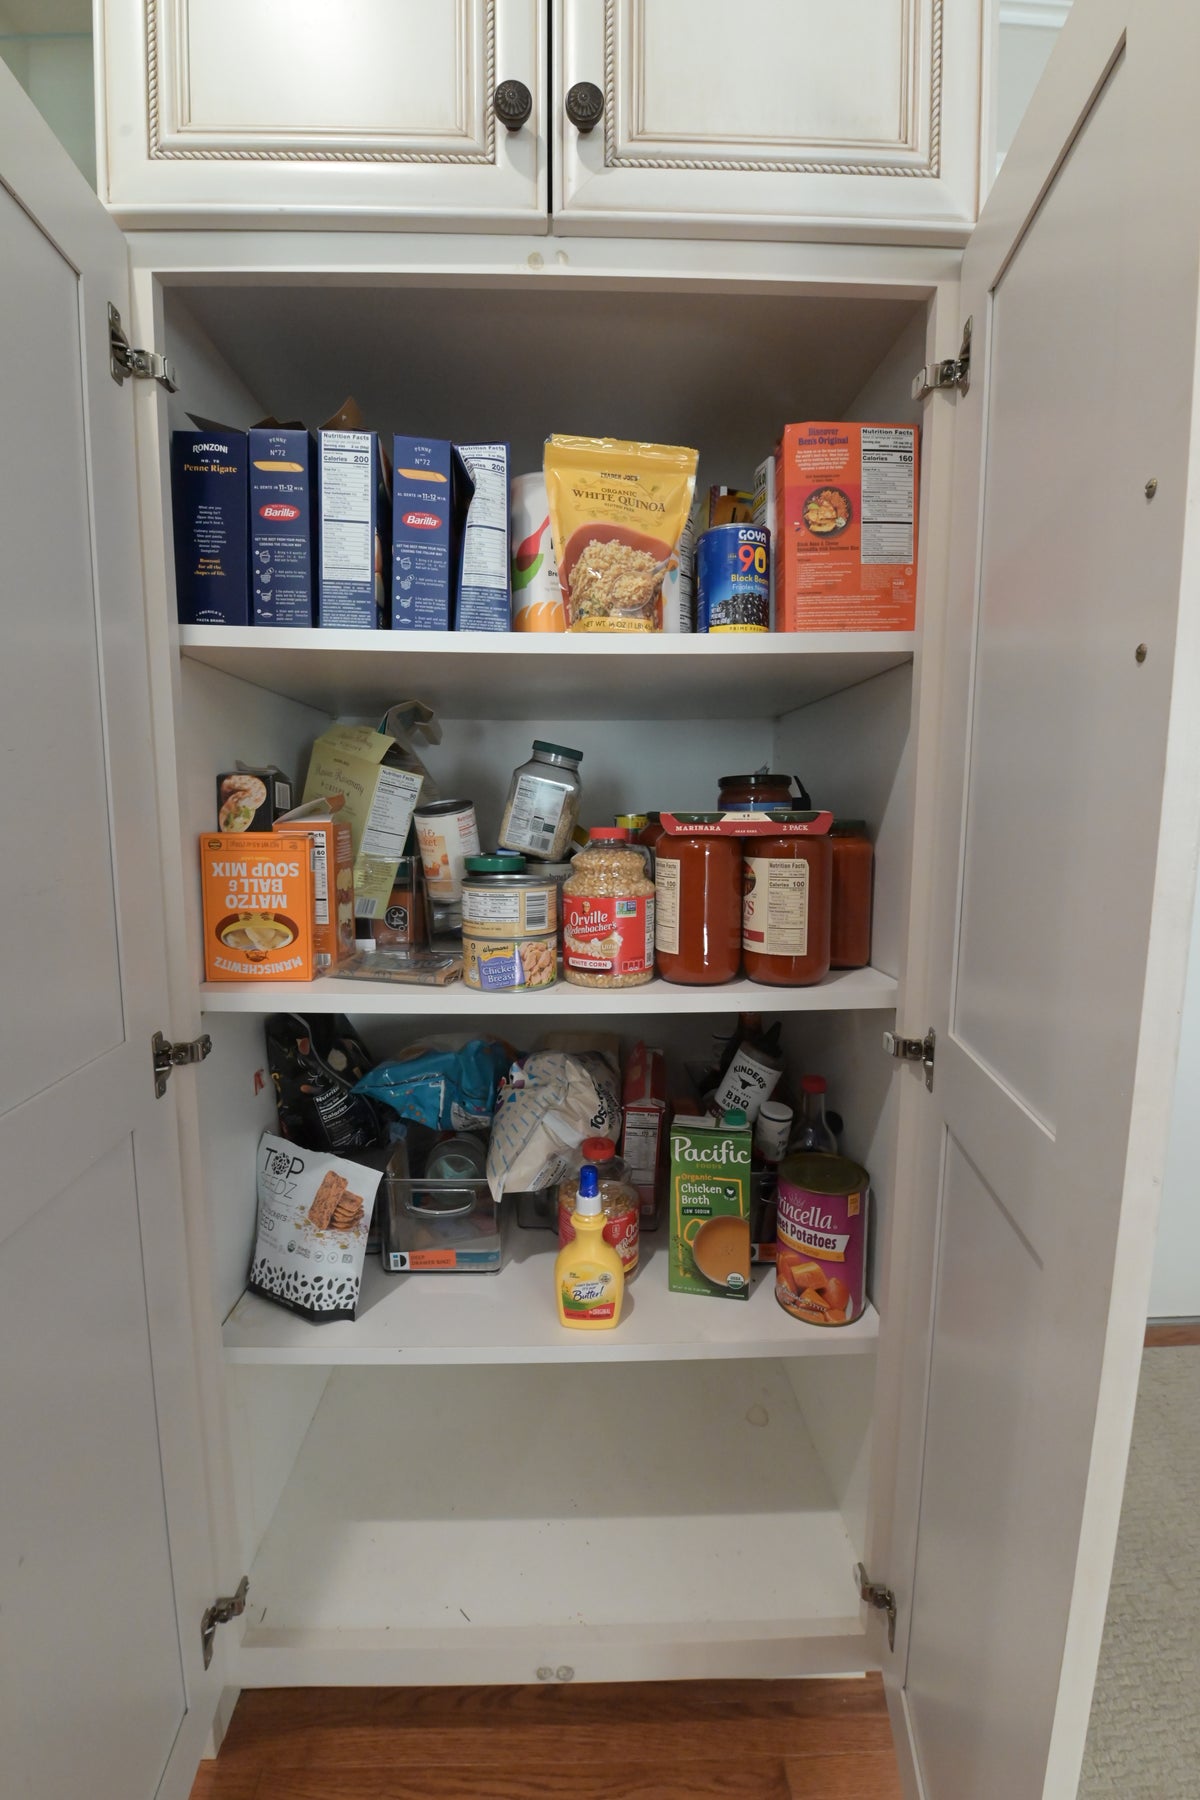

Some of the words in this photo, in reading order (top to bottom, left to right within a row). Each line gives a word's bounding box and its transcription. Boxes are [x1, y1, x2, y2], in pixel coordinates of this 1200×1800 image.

[818, 435, 849, 446] Original
[192, 443, 228, 454] RONZONI
[353, 455, 369, 463] 200
[184, 464, 209, 472] Penne
[210, 464, 238, 475] Rigate
[491, 463, 505, 473] 200
[600, 472, 622, 480] TRADER
[601, 487, 638, 497] ORGANIC
[572, 489, 616, 502] WHITE
[617, 495, 666, 512] QUINOA
[264, 508, 295, 517] Barilla
[406, 515, 437, 526] Barilla
[738, 529, 767, 542] GOYA
[738, 544, 767, 574] 90
[730, 573, 753, 583] Black
[382, 769, 402, 779] Nutrition
[675, 824, 722, 832] MARINARA
[211, 862, 247, 877] MIX
[251, 862, 300, 877] SOUP
[229, 879, 238, 892] &
[240, 878, 283, 893] BALL
[225, 894, 288, 909] MATZO
[570, 911, 608, 927] Orville
[214, 955, 303, 975] MANISCHEWITZ
[482, 964, 518, 975] Chicken
[488, 973, 516, 983] Breast
[733, 1064, 767, 1089] KINDER'S
[721, 1098, 740, 1110] SAU
[725, 1090, 750, 1110] BBQ
[322, 1104, 348, 1120] Calories
[670, 1135, 752, 1165] Pacific
[264, 1147, 305, 1179] TOP
[681, 1173, 712, 1183] Organic
[681, 1183, 722, 1194] Chicken
[681, 1194, 710, 1205] Broth
[776, 1217, 789, 1234] eet
[790, 1226, 837, 1250] Potatoes
[572, 1285, 605, 1302] Butter!
